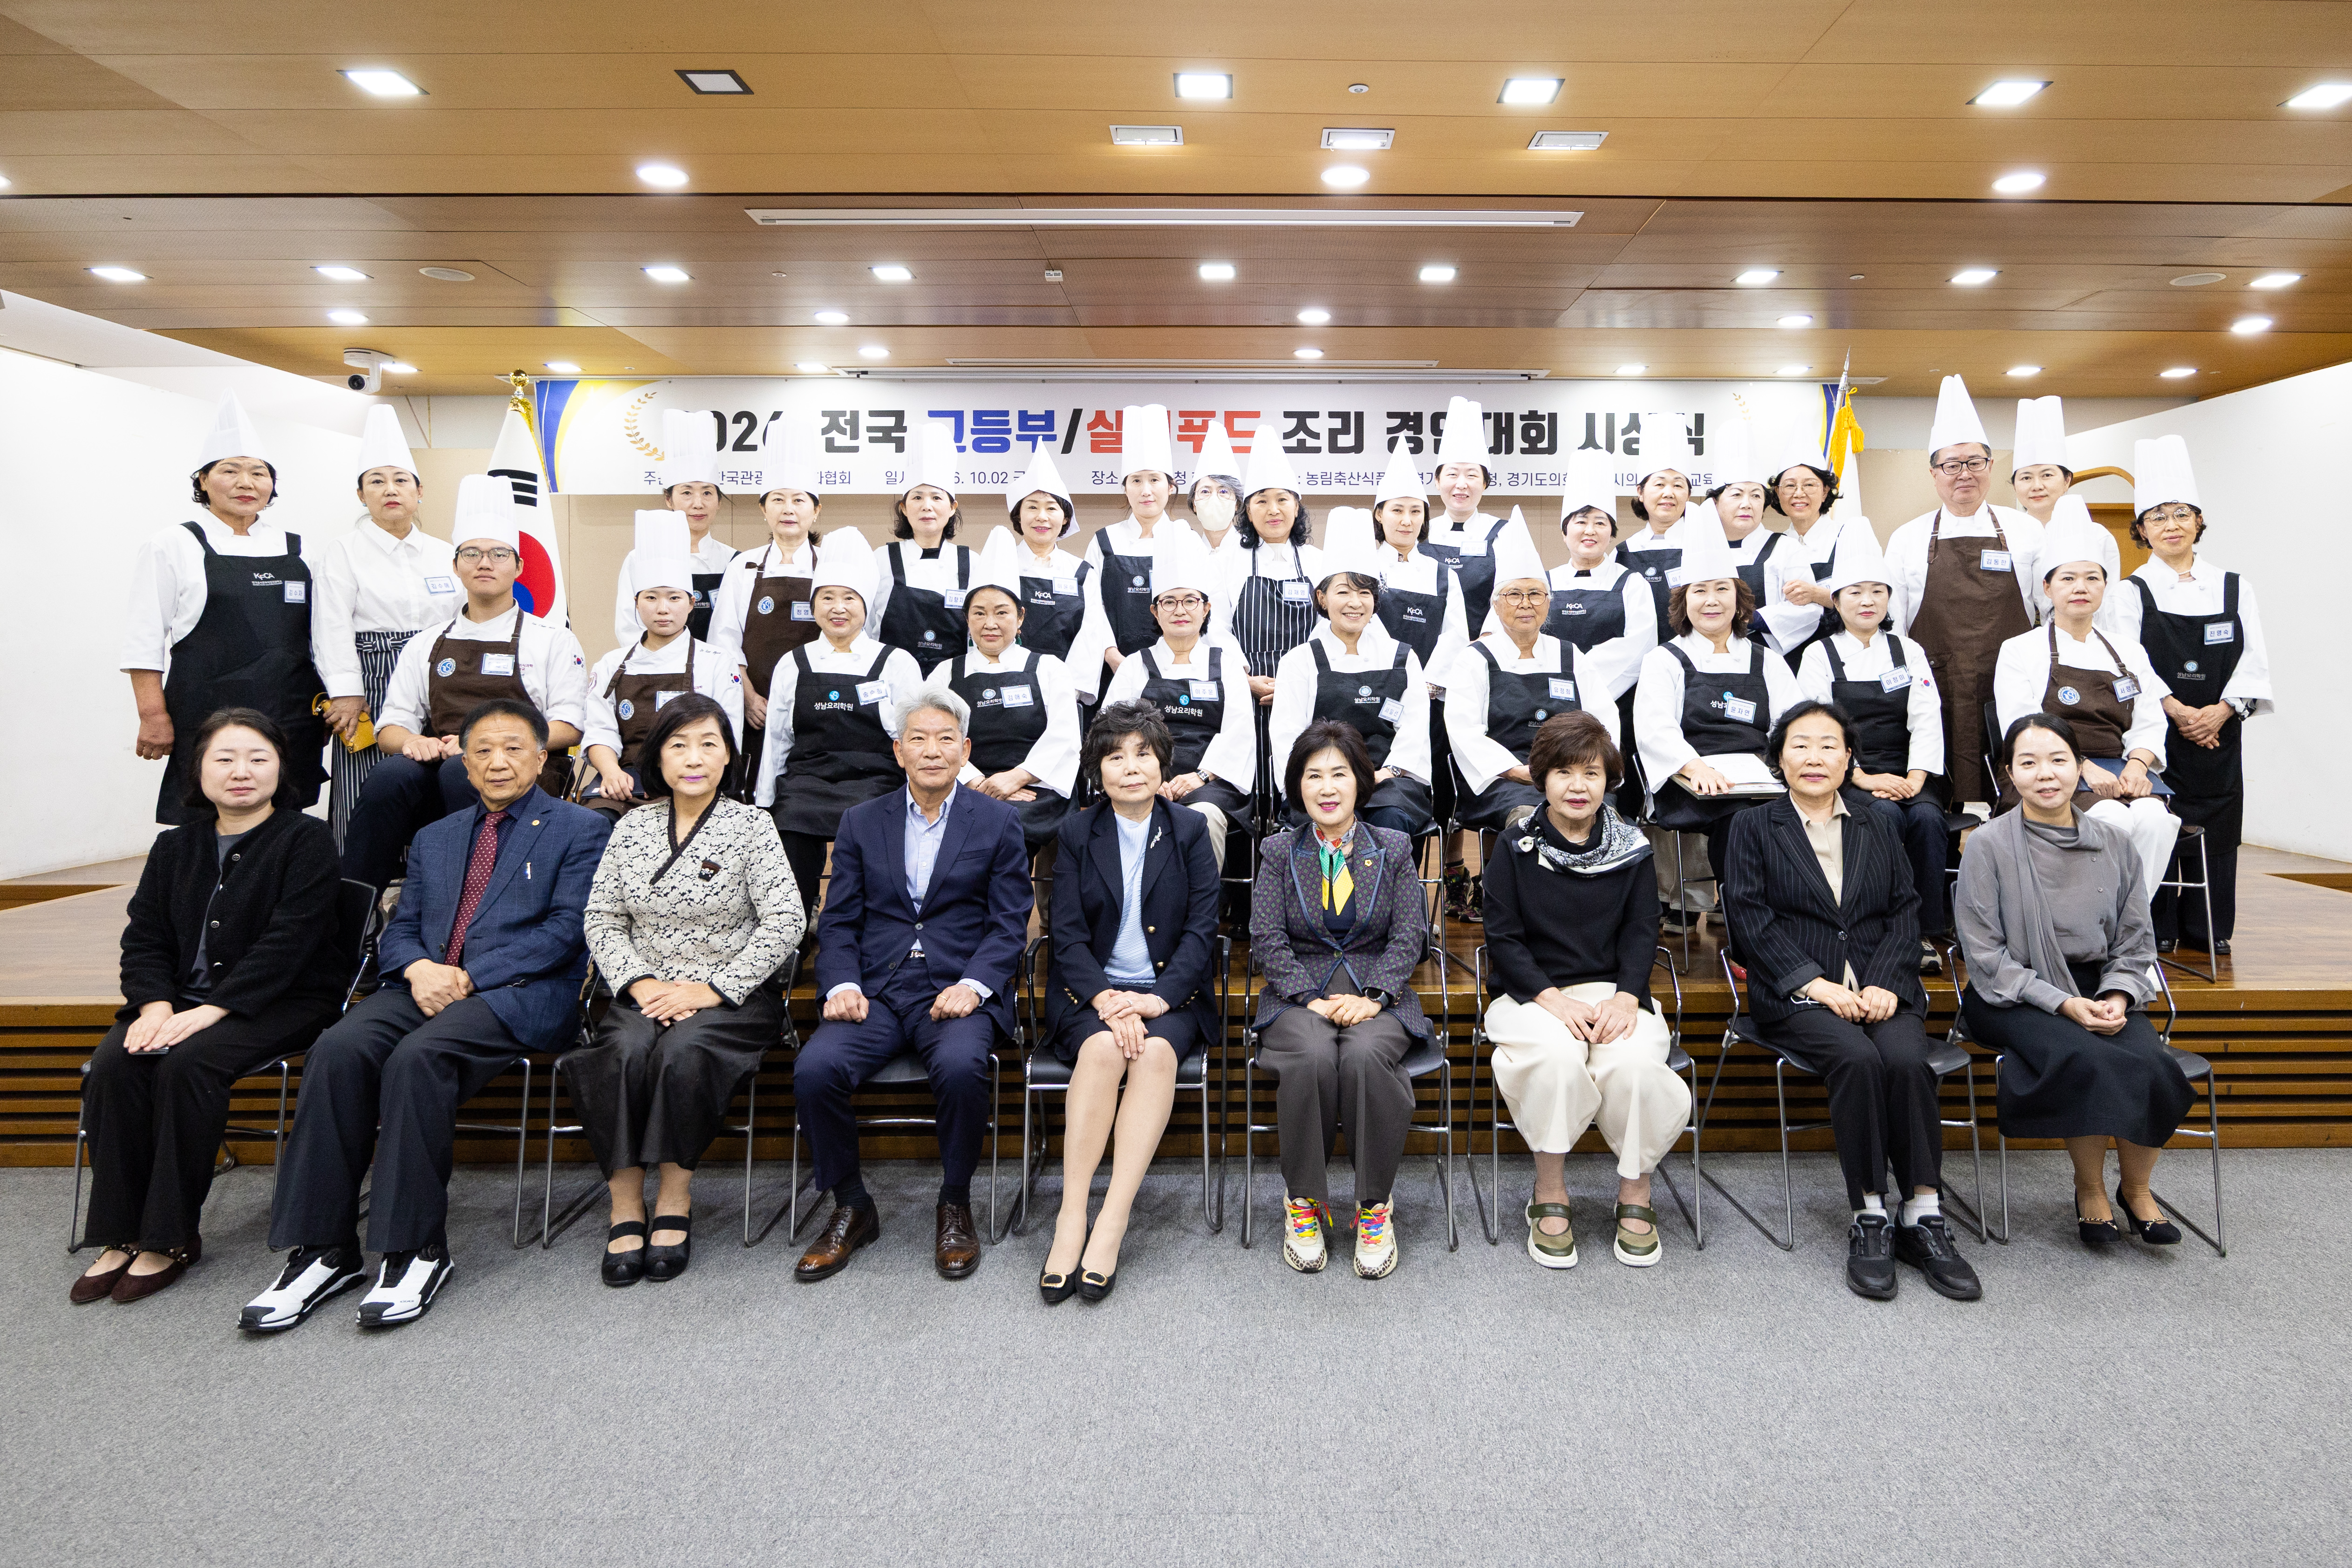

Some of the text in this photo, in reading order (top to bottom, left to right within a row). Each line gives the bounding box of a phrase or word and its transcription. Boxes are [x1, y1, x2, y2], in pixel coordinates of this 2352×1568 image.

[821, 410, 907, 453] 전국
[1283, 411, 1365, 454] 조리
[970, 471, 1008, 484] 10.02
[1091, 470, 1118, 485] 장소
[1035, 591, 1051, 599] KFCA
[1407, 607, 1423, 616] KFCA
[814, 702, 853, 711] 성남요리학원
[1164, 705, 1203, 717] 성남요리학원
